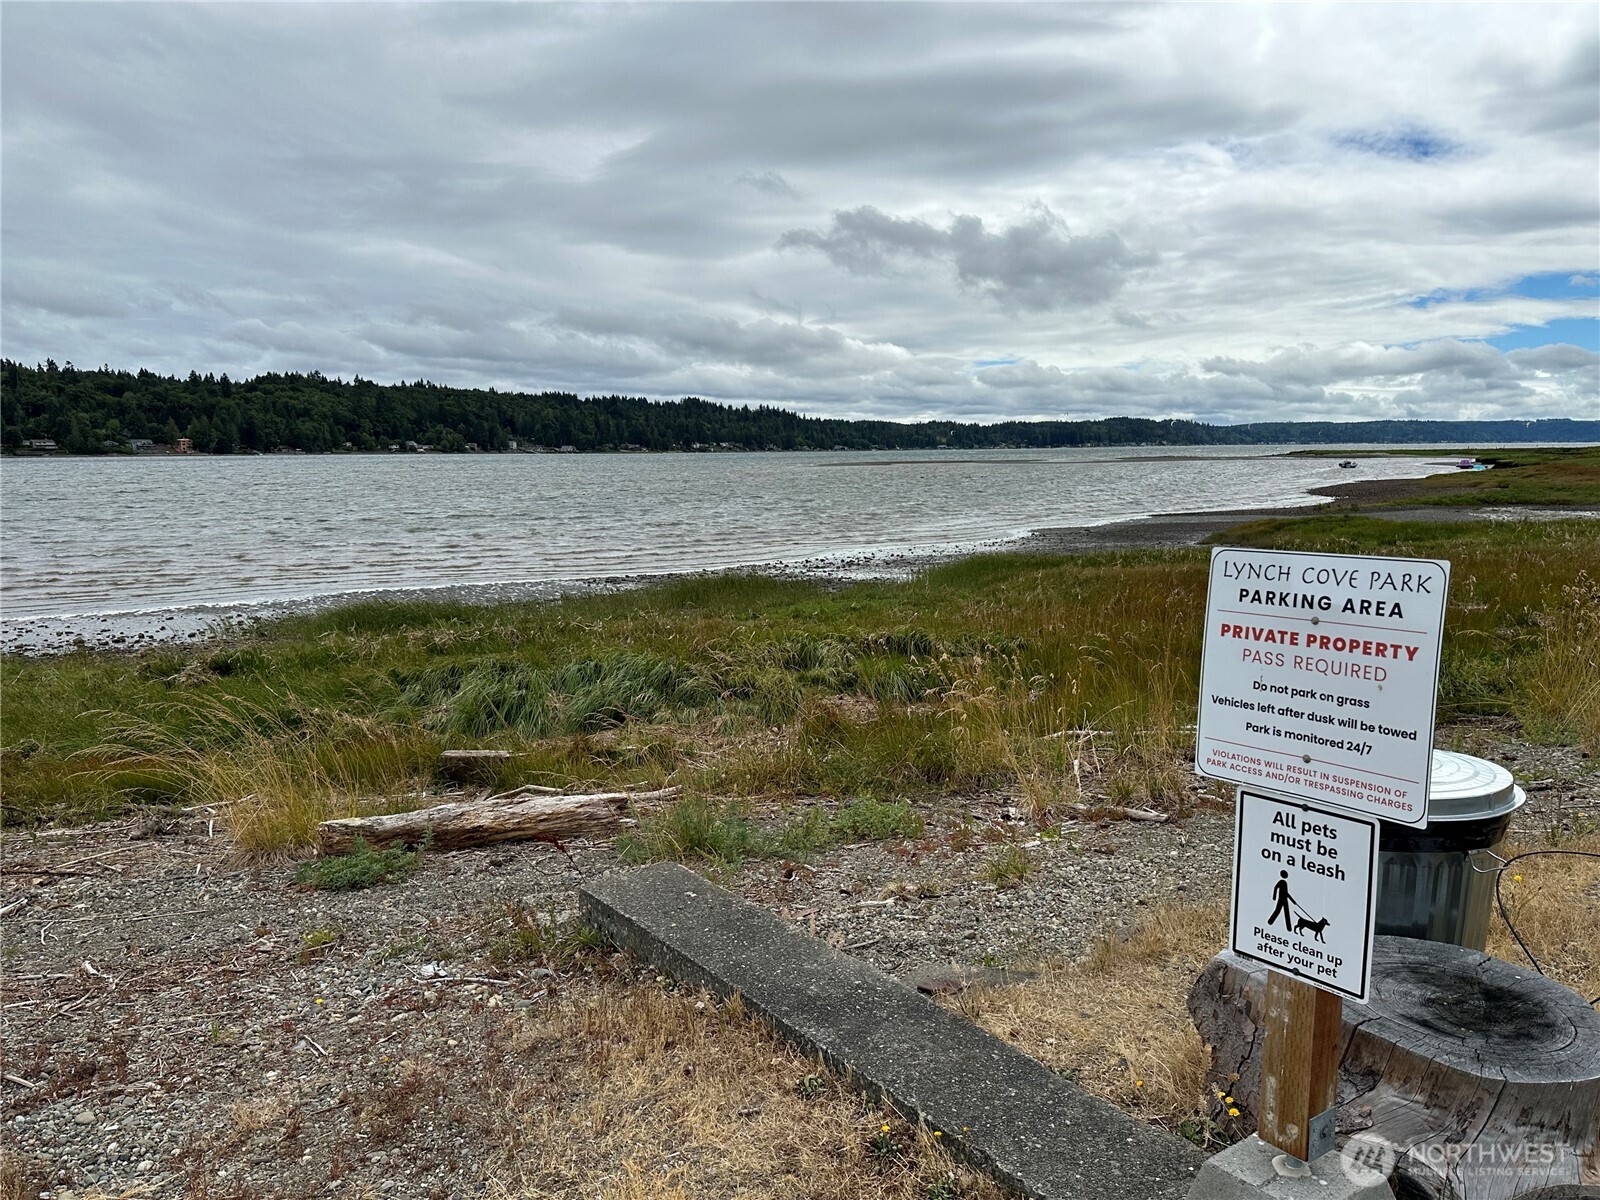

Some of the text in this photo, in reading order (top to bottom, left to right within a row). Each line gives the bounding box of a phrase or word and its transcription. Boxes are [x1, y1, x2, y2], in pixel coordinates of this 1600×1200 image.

[1224, 561, 1432, 594] LYNCH COVE PARK
[1239, 589, 1404, 619] PARKING AREA
[1220, 624, 1420, 661] PRIVATE PROPERTY
[1242, 649, 1387, 682] PASS REQUIRED
[1253, 681, 1370, 709] Do not park on grass
[1211, 695, 1417, 741] Vehicles left after dusk will be towed
[1246, 722, 1373, 756] Park is monitored 24/7
[1206, 758, 1413, 812] PARK ACCESS AND/OR TRESPASSING CHARGES
[1212, 749, 1407, 799] VIOLATIONS WILL RESULT IN SUSPENSION OF
[1273, 811, 1337, 839] All pets
[1270, 831, 1338, 859] must be
[1261, 848, 1345, 881] on a leash
[1254, 927, 1343, 967] Please clean up
[1257, 942, 1337, 978] after your pet
